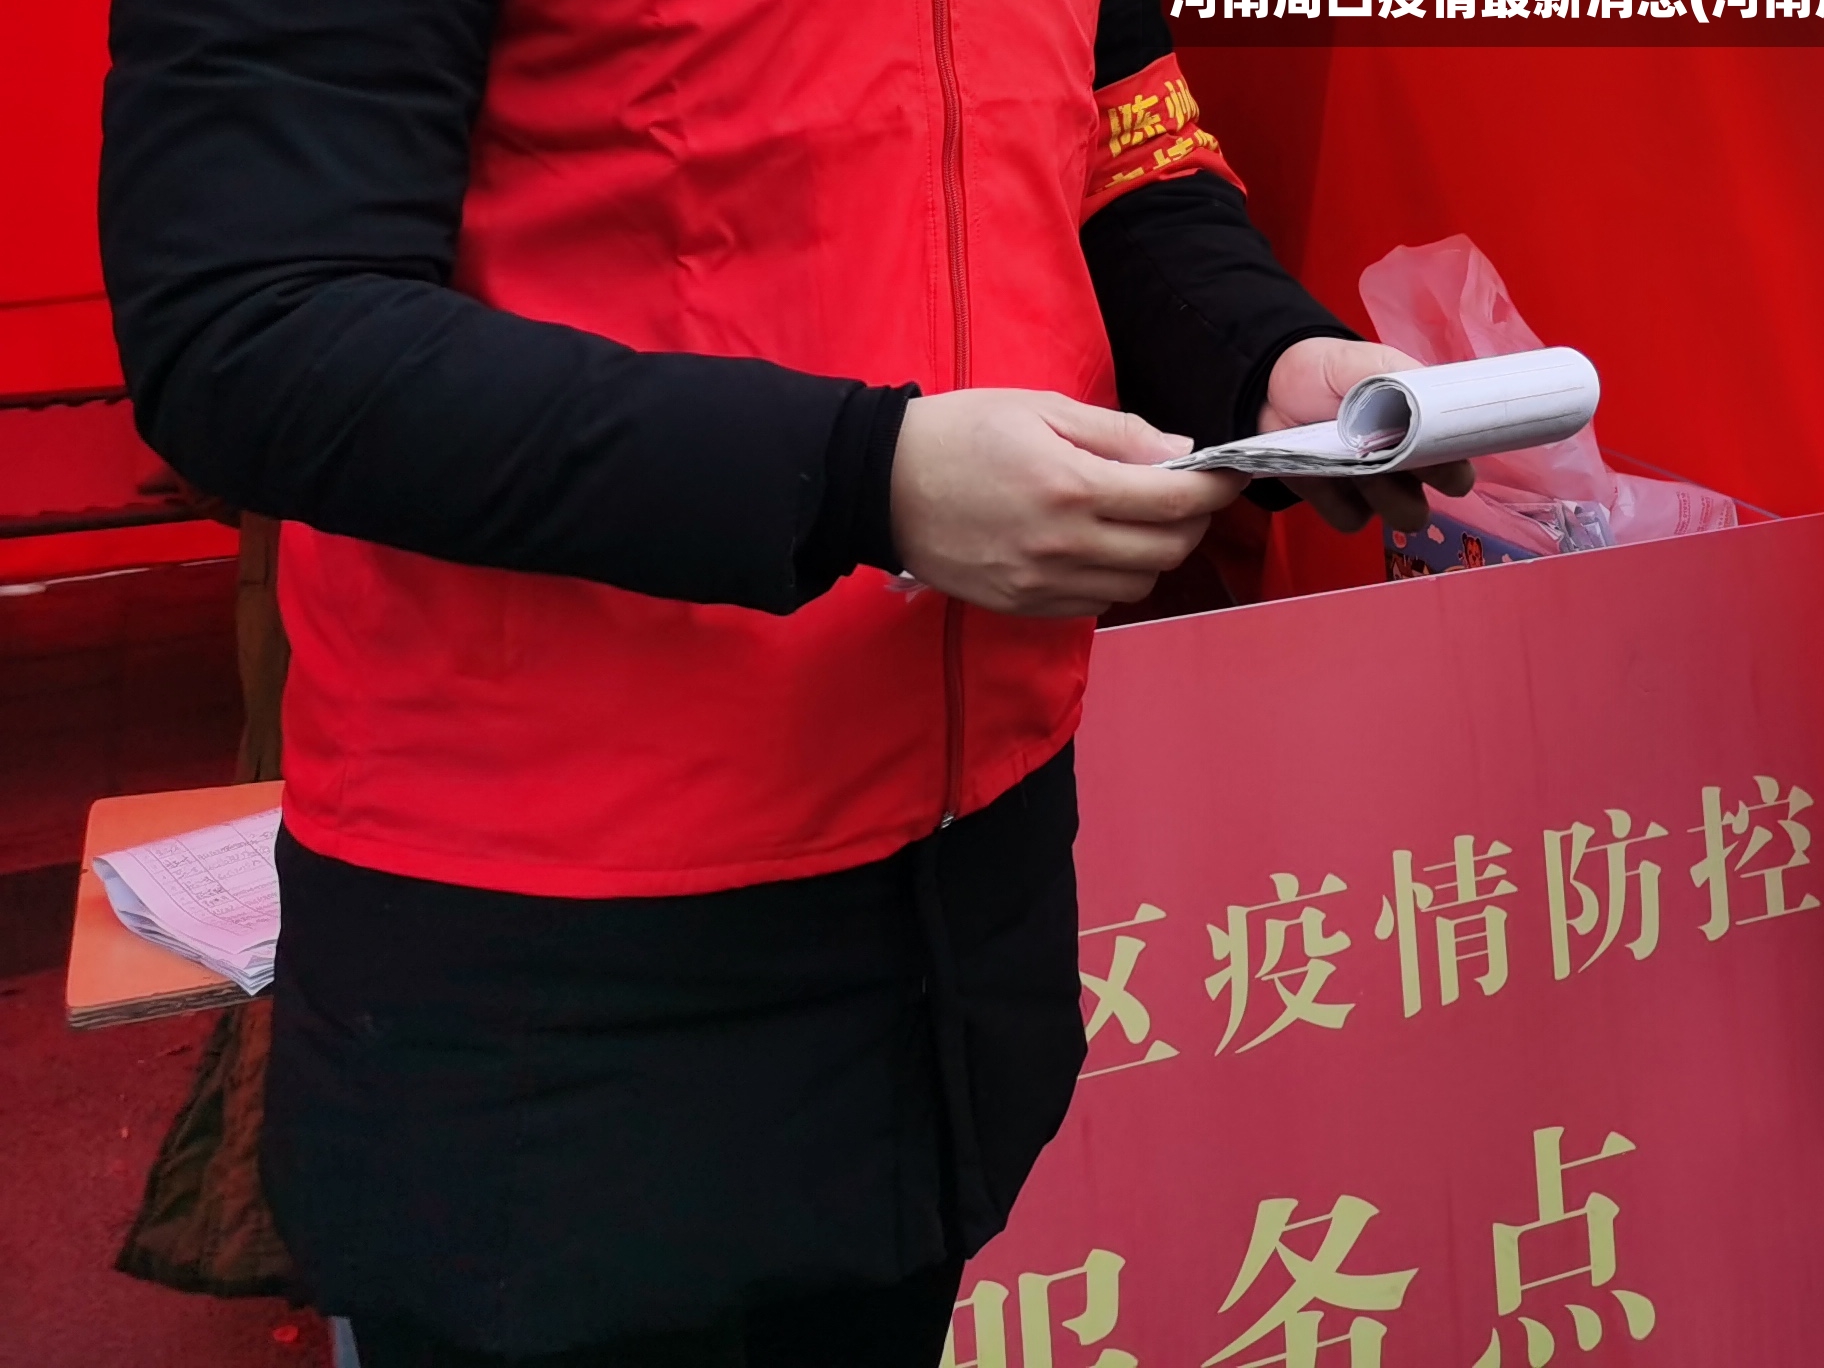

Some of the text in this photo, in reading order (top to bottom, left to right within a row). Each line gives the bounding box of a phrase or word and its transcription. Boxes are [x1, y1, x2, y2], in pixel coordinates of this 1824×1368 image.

[1078, 775, 1821, 1080] 区疫情防控
